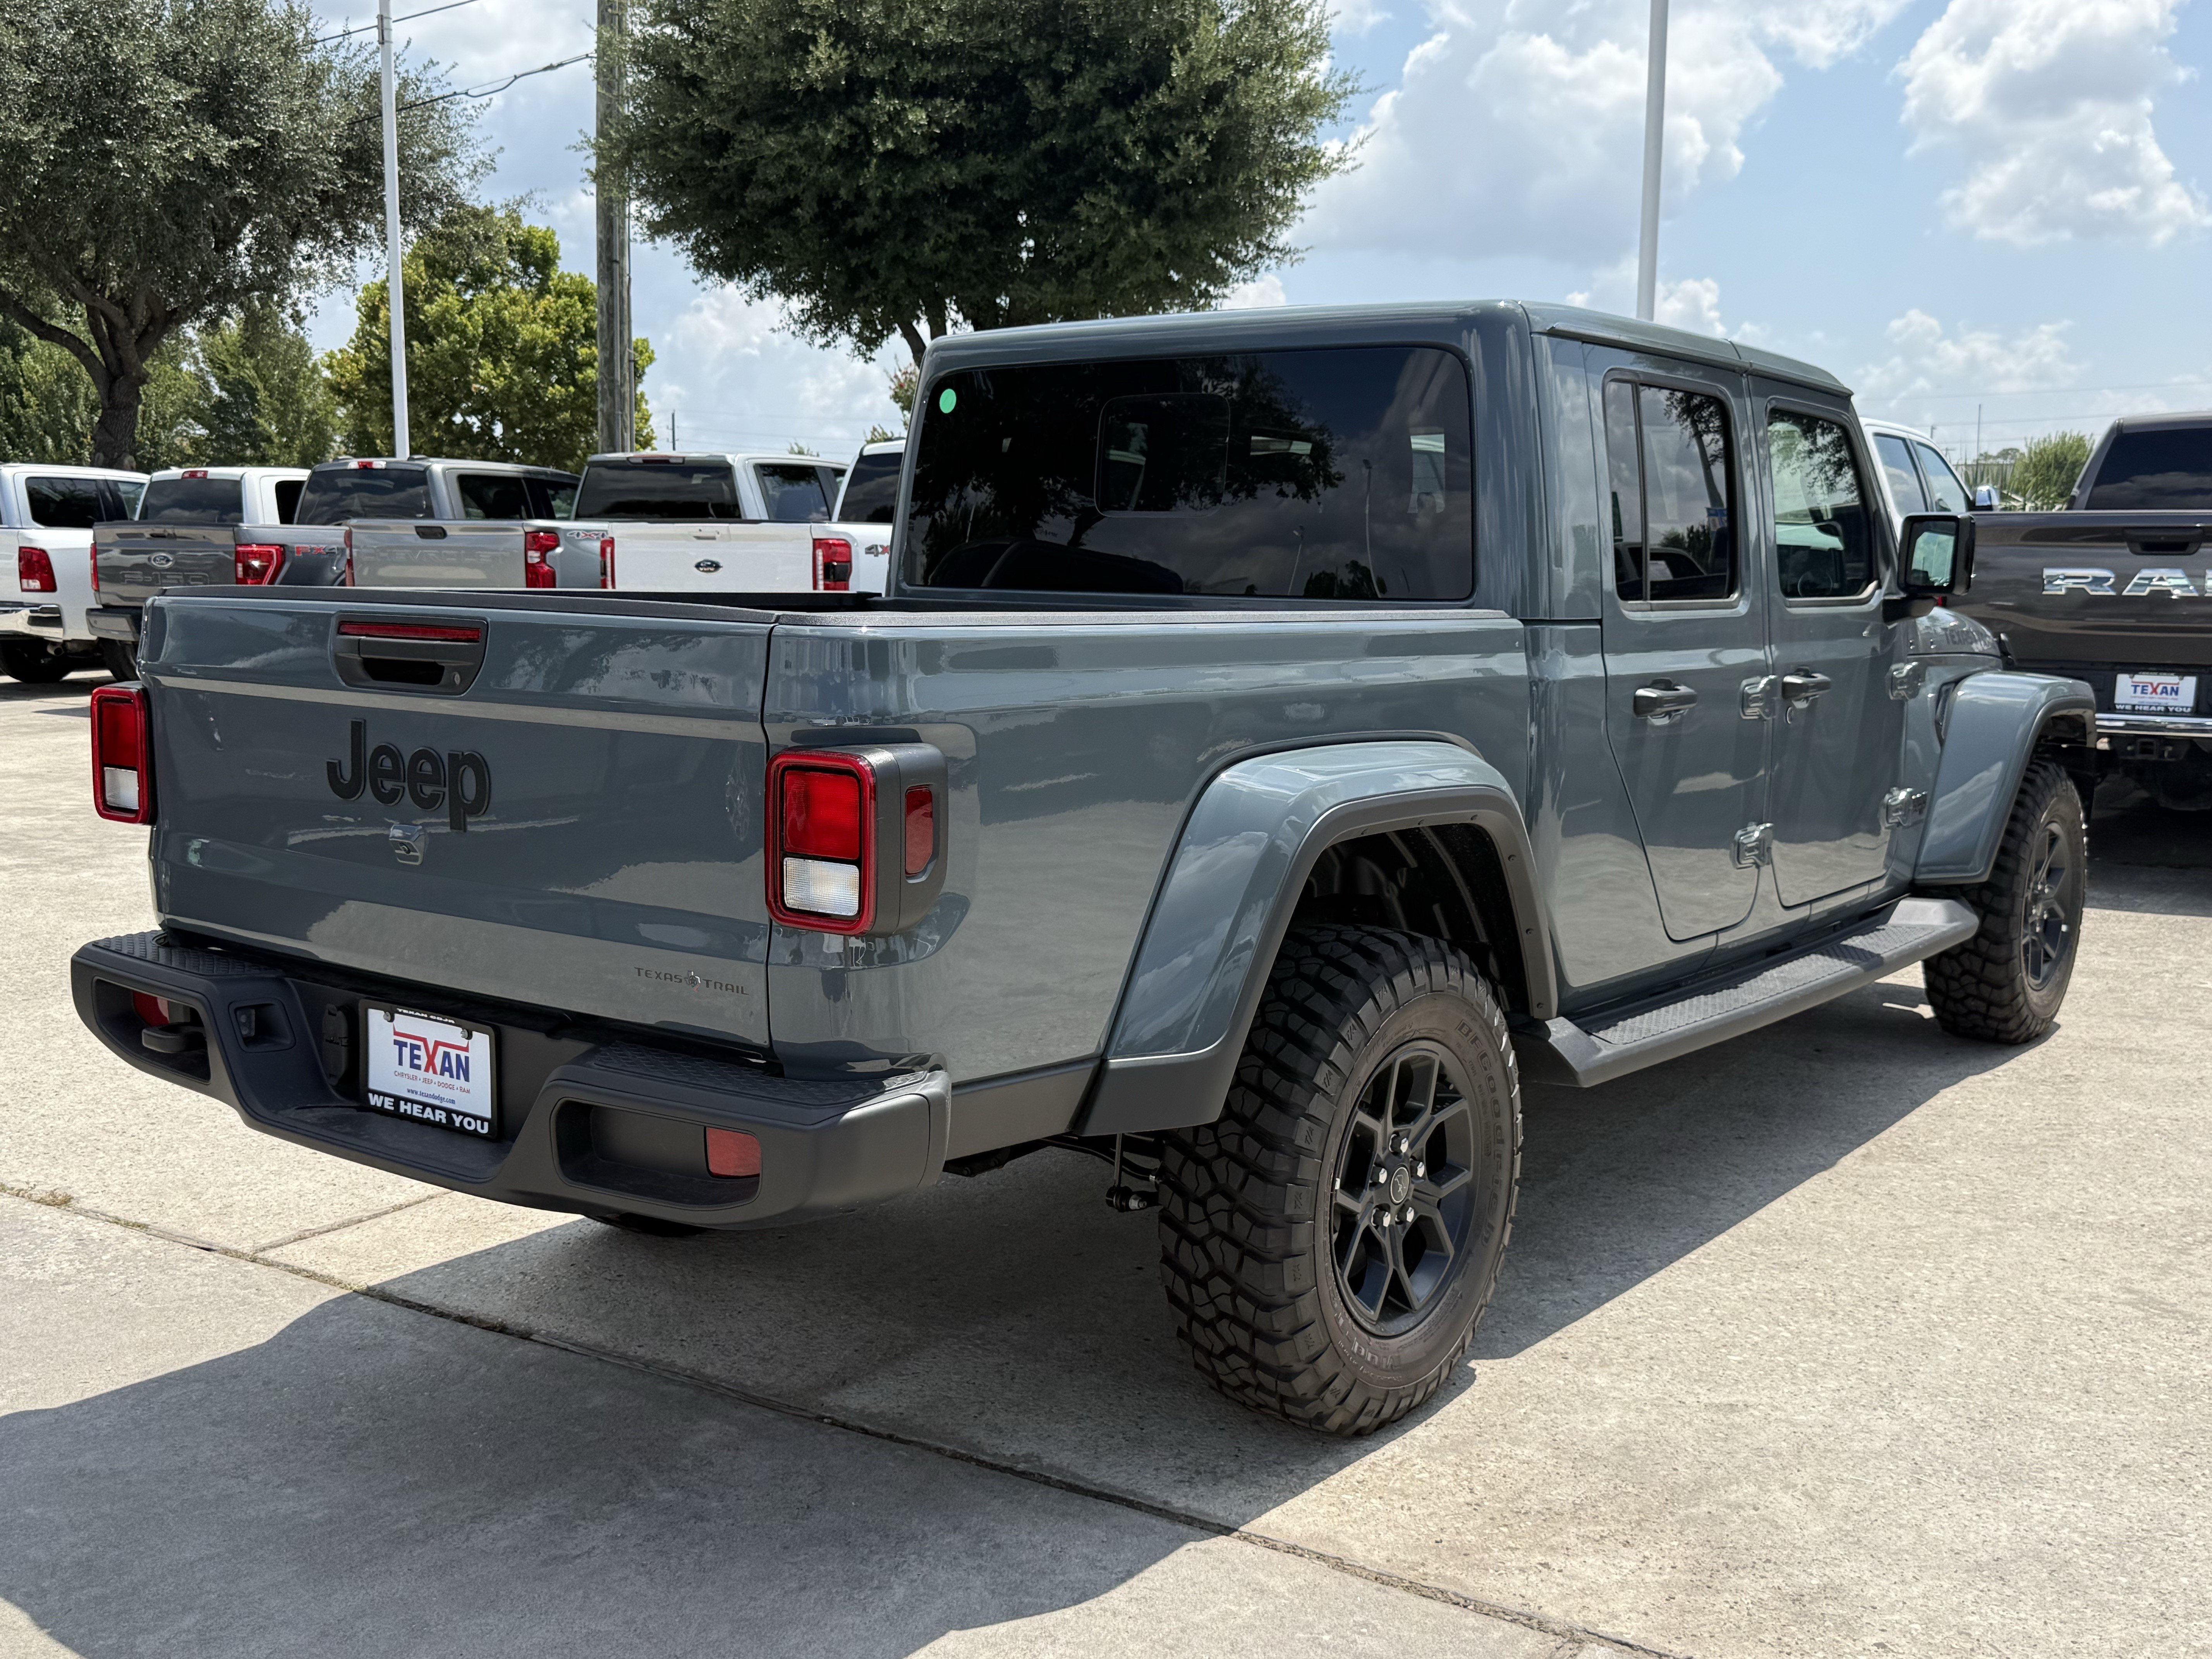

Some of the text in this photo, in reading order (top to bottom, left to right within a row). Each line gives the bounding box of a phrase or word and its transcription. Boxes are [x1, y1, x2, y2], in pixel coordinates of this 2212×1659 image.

[567, 530, 608, 539] 4X4
[295, 545, 338, 556] FX4
[2042, 567, 2212, 597] RA
[2131, 682, 2179, 696] TEXAN
[326, 717, 492, 833] Jeep
[634, 966, 749, 995] TEXAS TRAIL
[1376, 985, 1388, 1000] T/A
[397, 1008, 455, 1024] TEXAN CDJR
[1345, 1023, 1357, 1041] T/A
[393, 1035, 470, 1083] TEXAN
[394, 1070, 471, 1094] CHRYSLER JEEP DODGE RAM
[1322, 1069, 1333, 1089] T/A
[407, 1087, 456, 1105] www.texandodge.com
[368, 1093, 489, 1135] WE HEAR YOU
[1305, 1125, 1315, 1146] T/A
[1455, 1019, 1505, 1248] BFGoodrich
